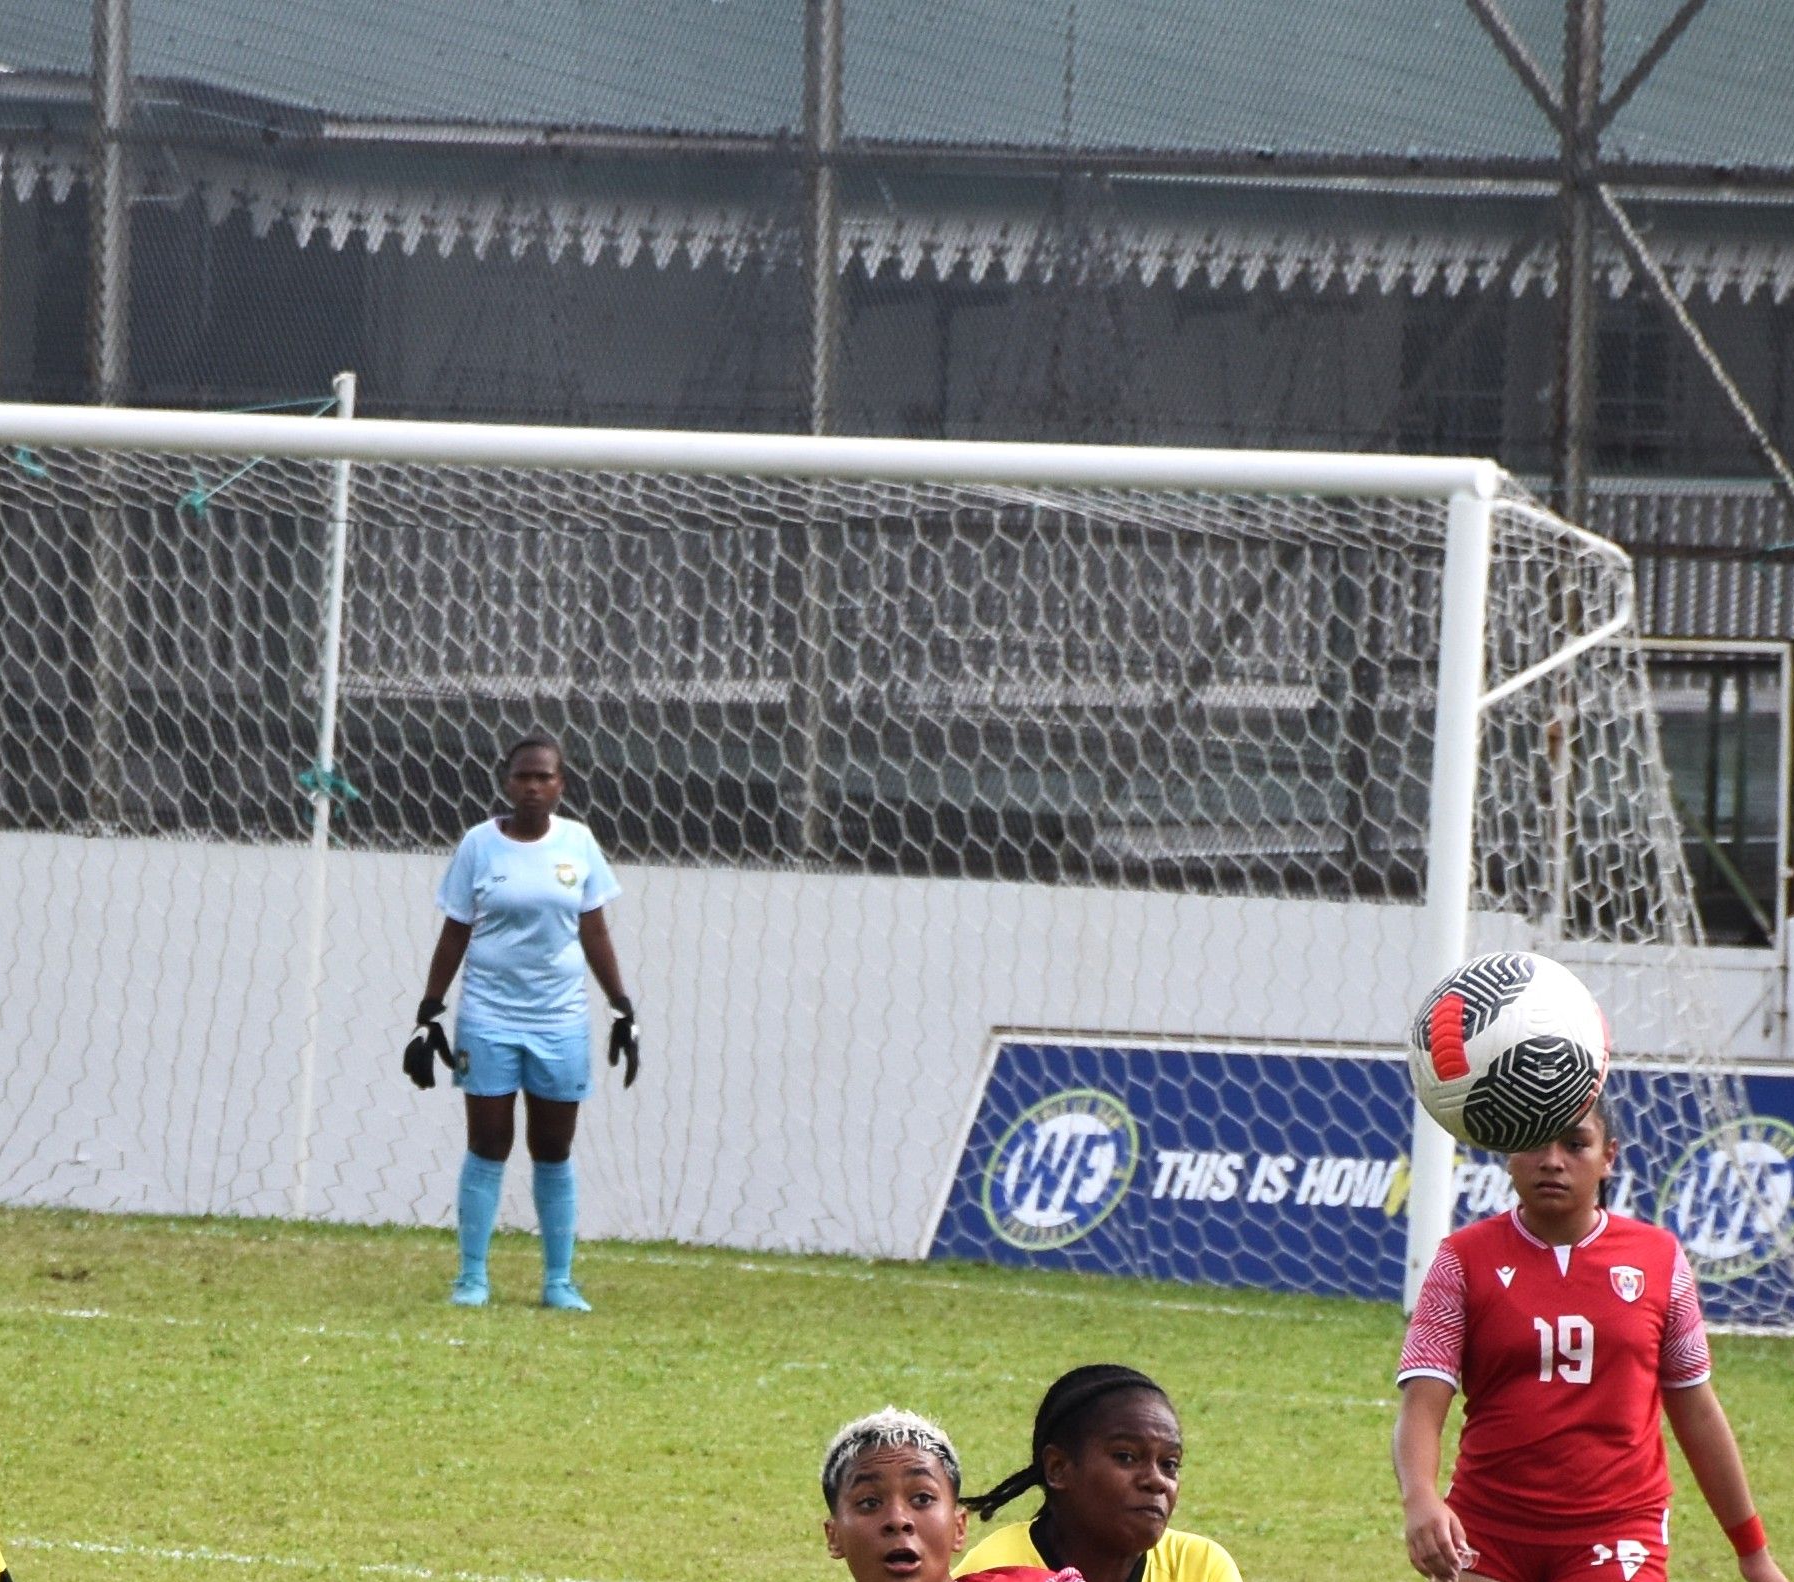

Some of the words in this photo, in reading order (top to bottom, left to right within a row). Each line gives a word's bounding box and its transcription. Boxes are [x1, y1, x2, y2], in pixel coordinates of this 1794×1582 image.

[1151, 1150, 1245, 1202] THIS
[1246, 1154, 1296, 1204] IS
[1295, 1156, 1401, 1208] HOW
[1533, 1315, 1594, 1384] 19
